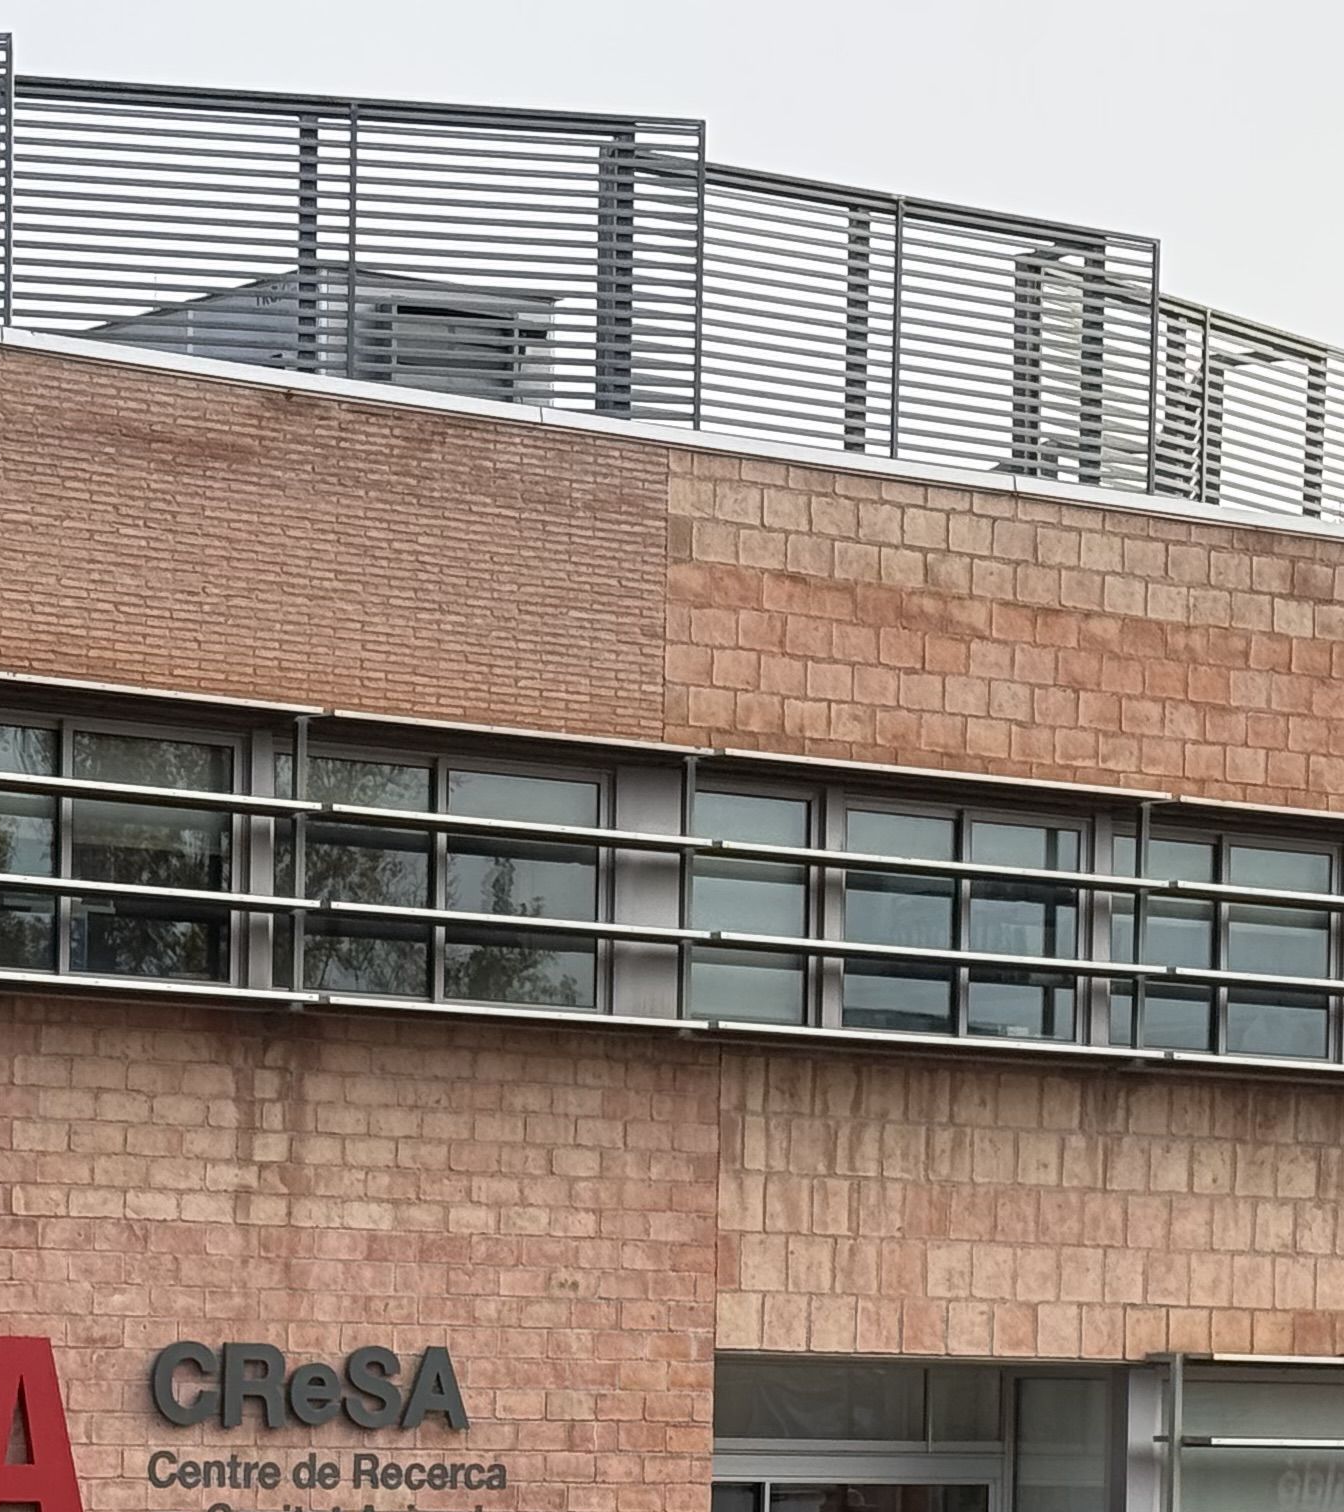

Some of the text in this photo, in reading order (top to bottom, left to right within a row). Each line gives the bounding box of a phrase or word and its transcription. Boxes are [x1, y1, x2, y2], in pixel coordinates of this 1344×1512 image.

[151, 1340, 469, 1430] CReSA
[147, 1450, 507, 1491] Centre de Recerca
